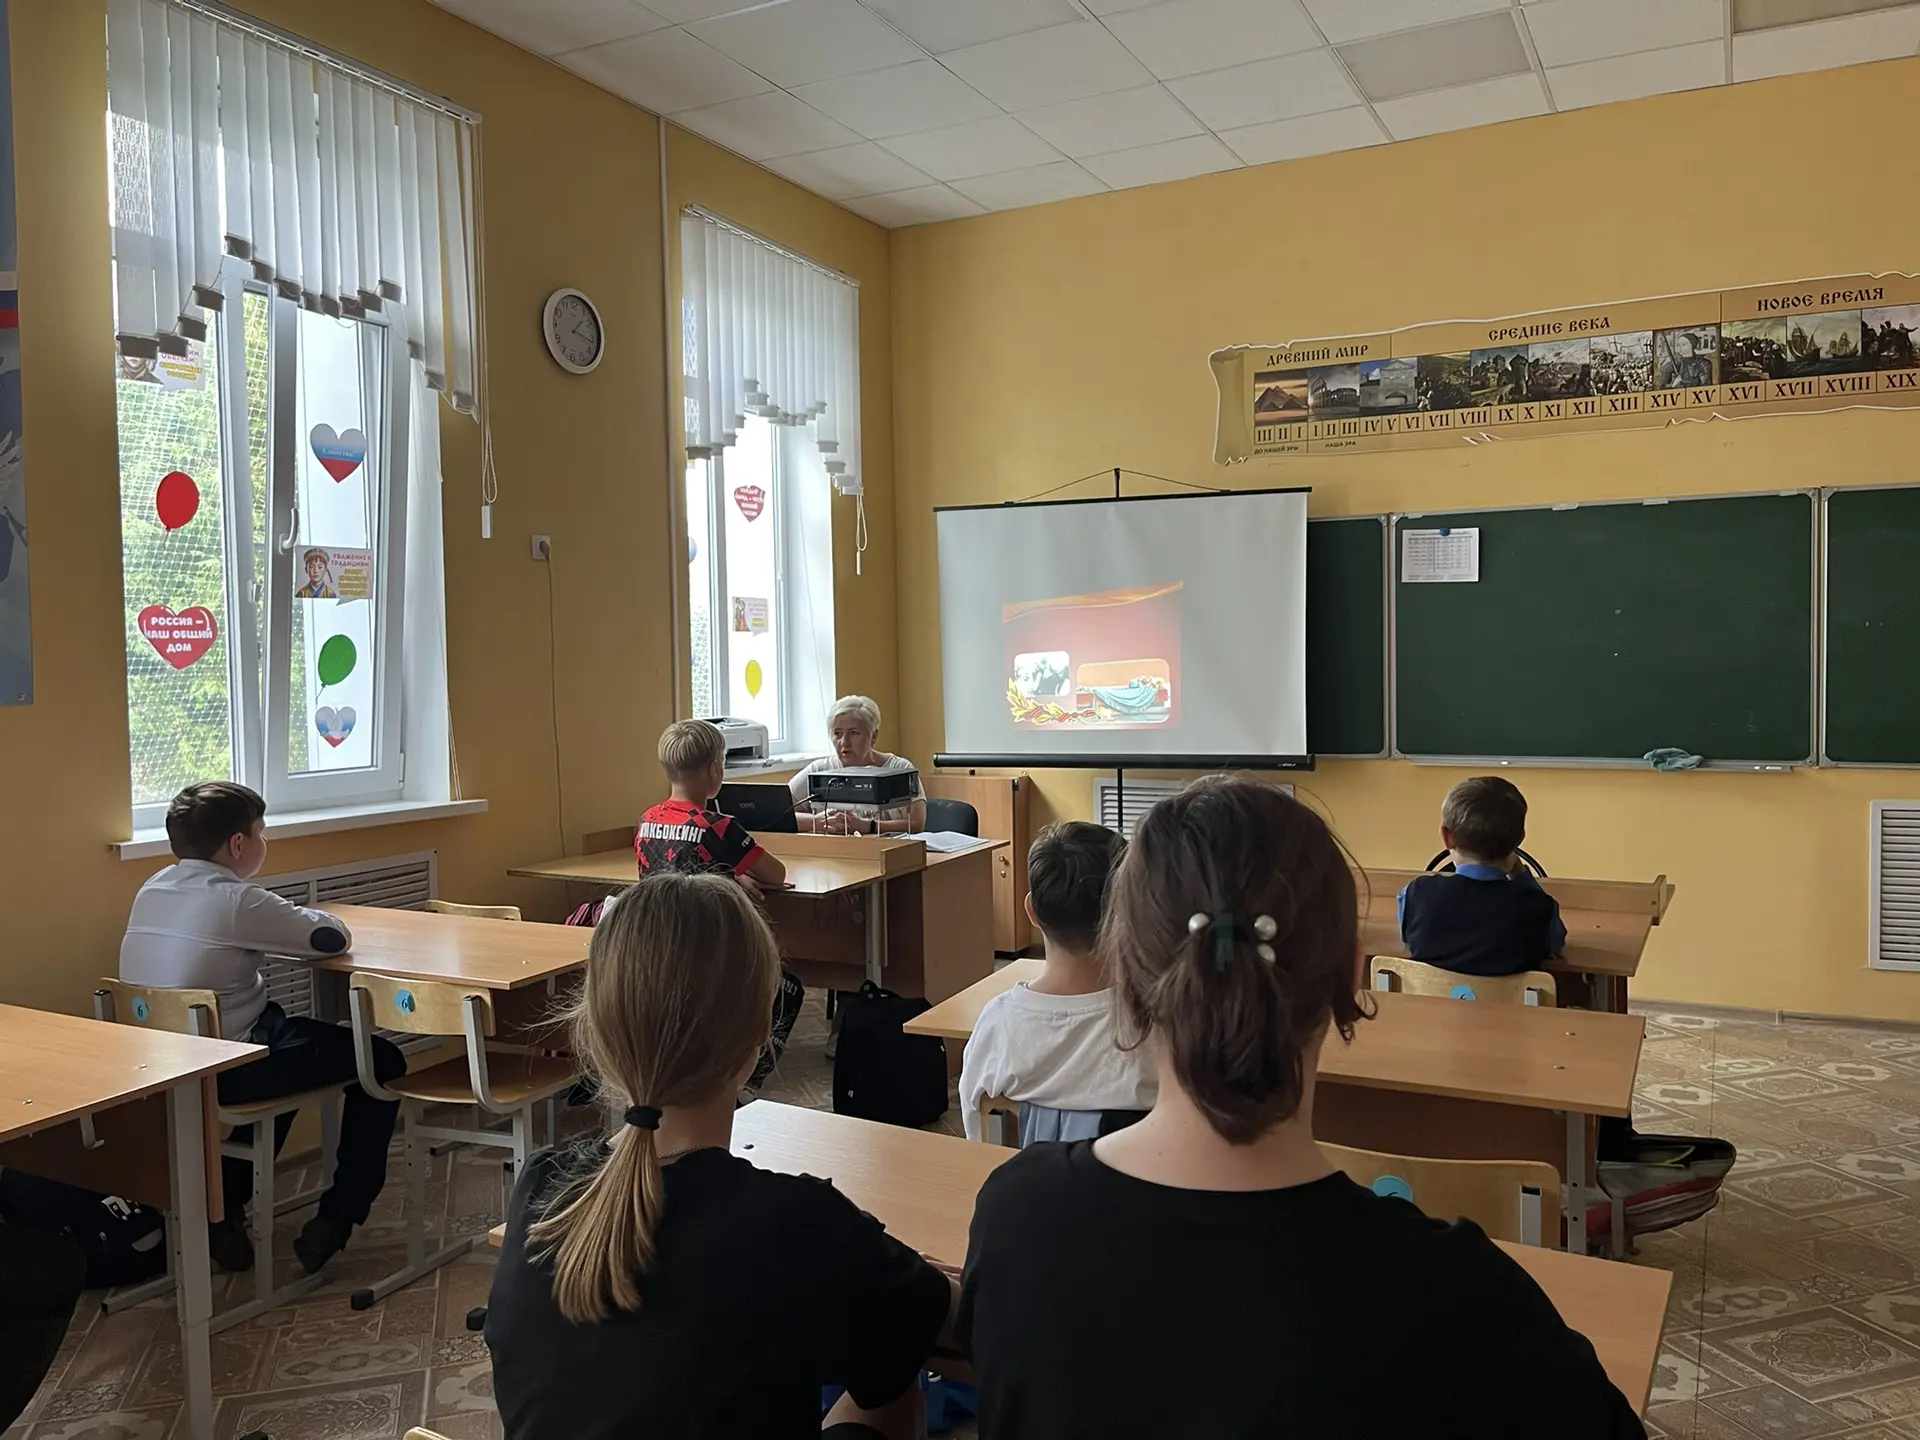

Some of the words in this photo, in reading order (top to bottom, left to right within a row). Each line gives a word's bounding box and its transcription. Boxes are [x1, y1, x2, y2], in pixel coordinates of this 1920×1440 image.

[1757, 294, 1814, 311] НОВОЕ
[1820, 287, 1884, 305] ВРЕМЯ
[1488, 322, 1563, 341] СРЕДНИЕ
[1569, 316, 1610, 332] ВЕКА
[1266, 347, 1330, 367] ДРЕВНИЙ
[1335, 345, 1368, 359] МИР
[1257, 429, 1272, 442] III
[1278, 427, 1288, 440] II
[1298, 426, 1302, 438] I
[1314, 425, 1318, 437] I
[1326, 423, 1336, 436] II
[1342, 421, 1357, 434] III
[1365, 420, 1380, 432] IV
[1387, 418, 1396, 431] V
[1405, 416, 1420, 429] VI
[1429, 413, 1449, 427] VII
[1460, 411, 1487, 425] VIII
[1498, 408, 1513, 421] IX
[1524, 406, 1534, 420] X
[1544, 404, 1561, 418] XI
[1572, 400, 1595, 415] XII
[1608, 396, 1638, 412] XIII
[1650, 392, 1681, 408] XIV
[1691, 389, 1716, 404] XV
[1728, 385, 1760, 401] XVI
[1775, 381, 1813, 397] XVII
[1825, 376, 1871, 393] XVIII
[1885, 372, 1917, 389] XIX
[1264, 445, 1285, 453] НАШЕЙ
[151, 616, 193, 626] РОССИЯ
[145, 629, 169, 639] НАШ
[172, 628, 213, 639] ОБЩИЙ
[166, 643, 192, 653] ДОМ
